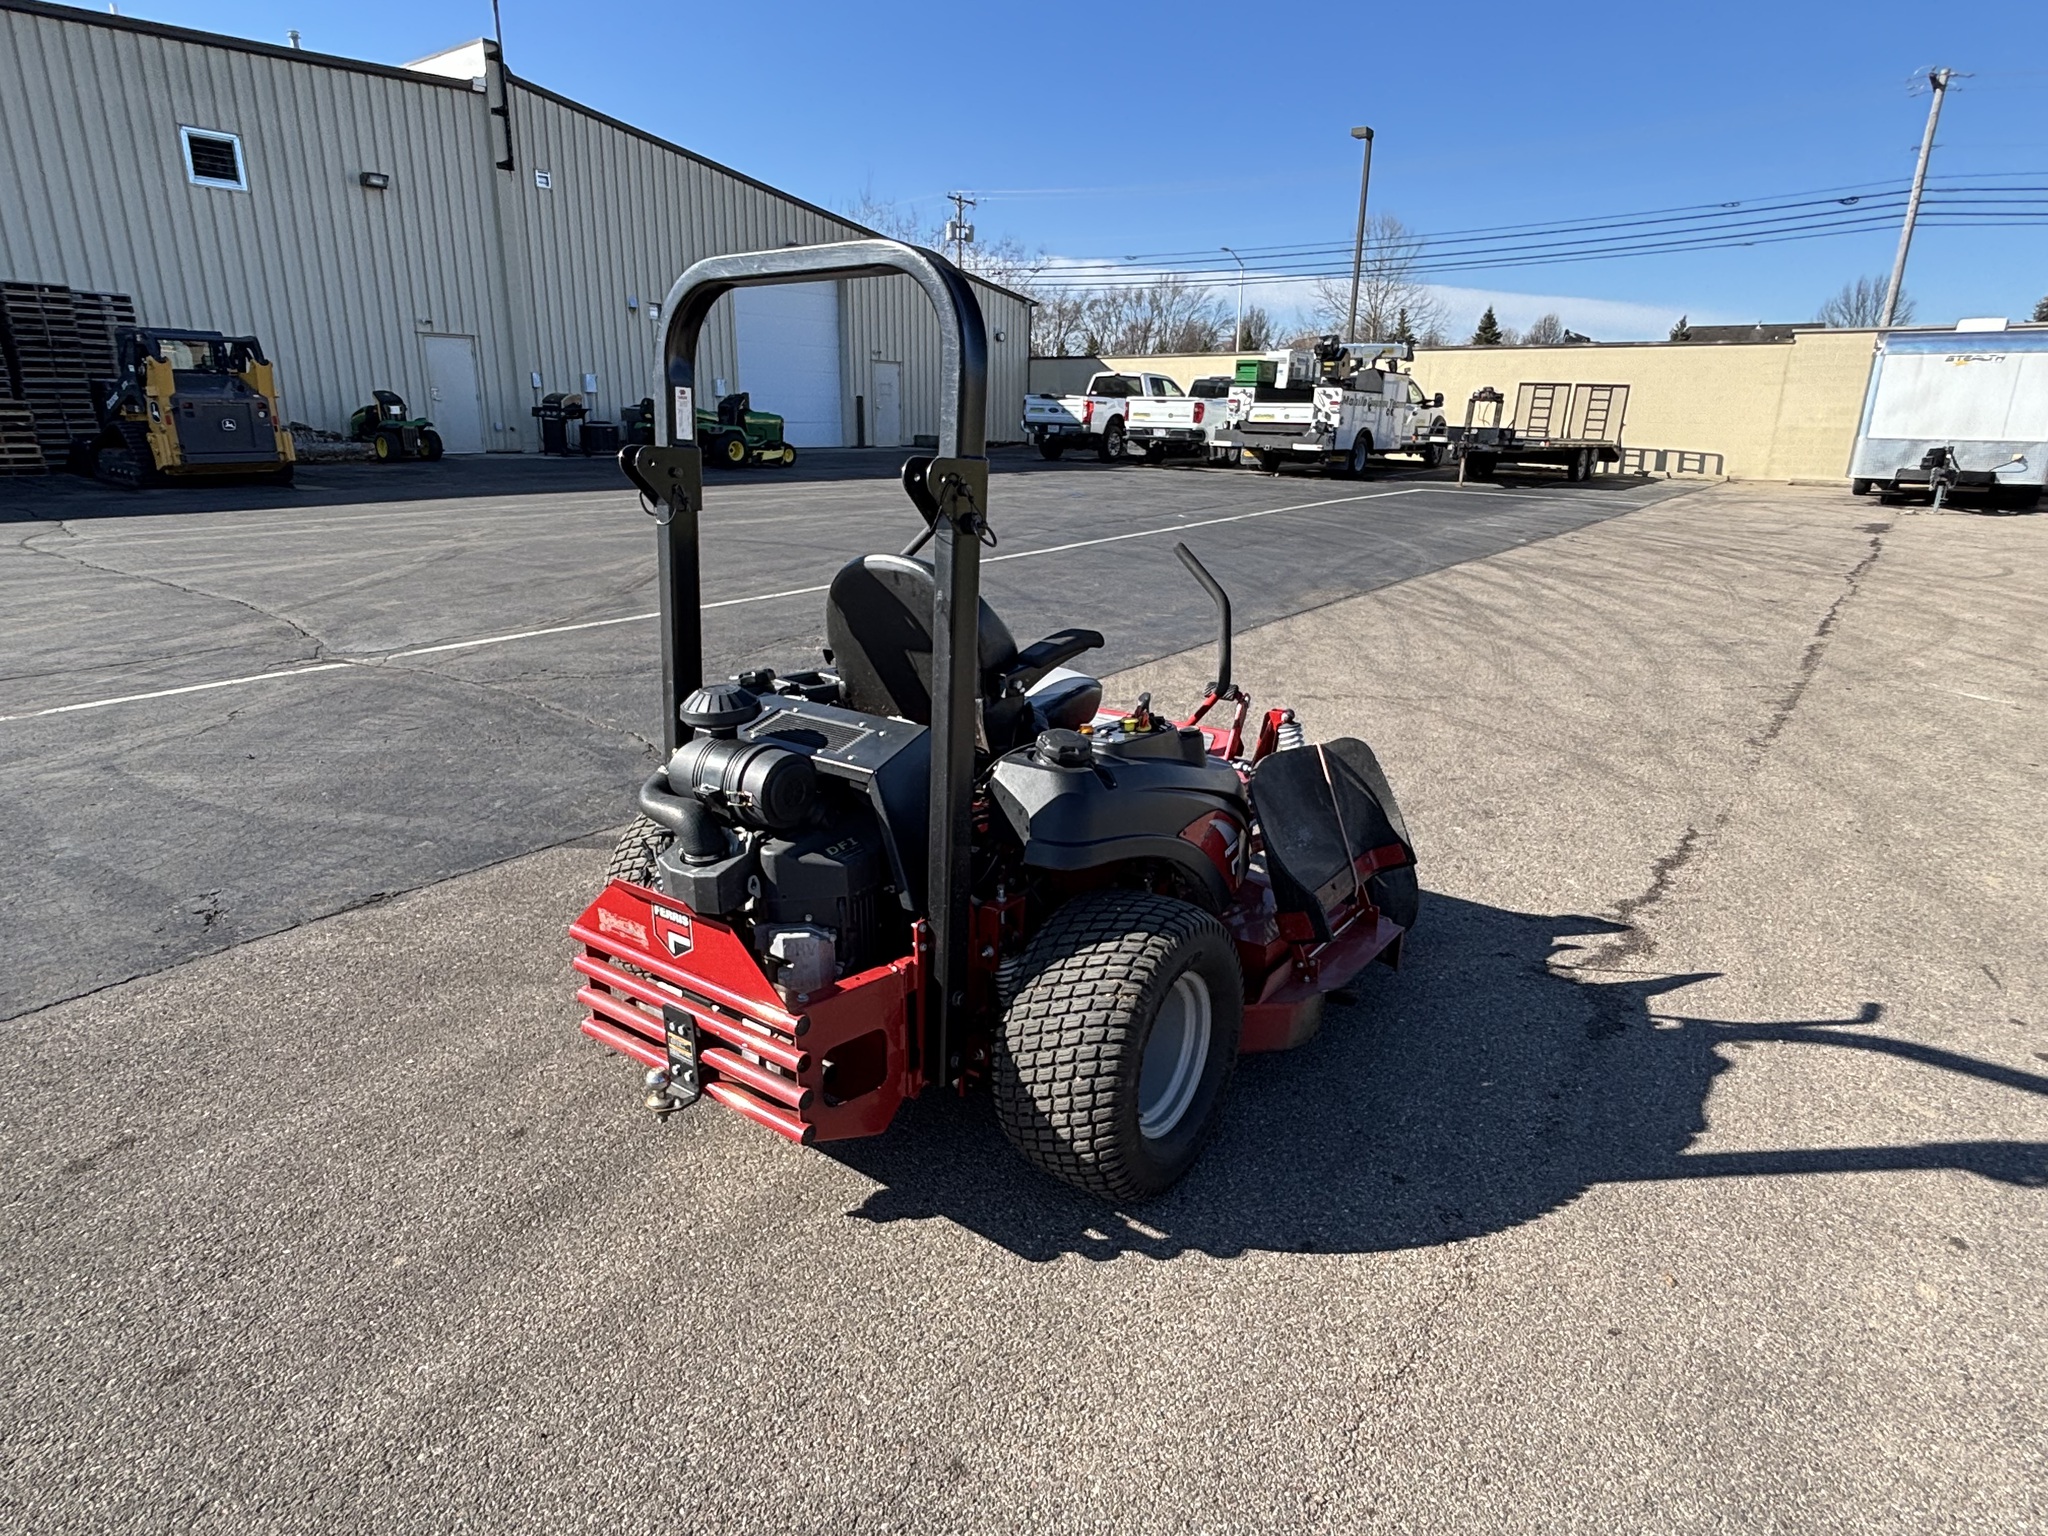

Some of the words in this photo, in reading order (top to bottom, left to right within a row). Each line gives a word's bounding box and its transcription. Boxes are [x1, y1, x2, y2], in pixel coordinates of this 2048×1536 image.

[1342, 395, 1368, 407] Mobile
[825, 837, 859, 856] DFI
[654, 904, 689, 927] FERRIS
